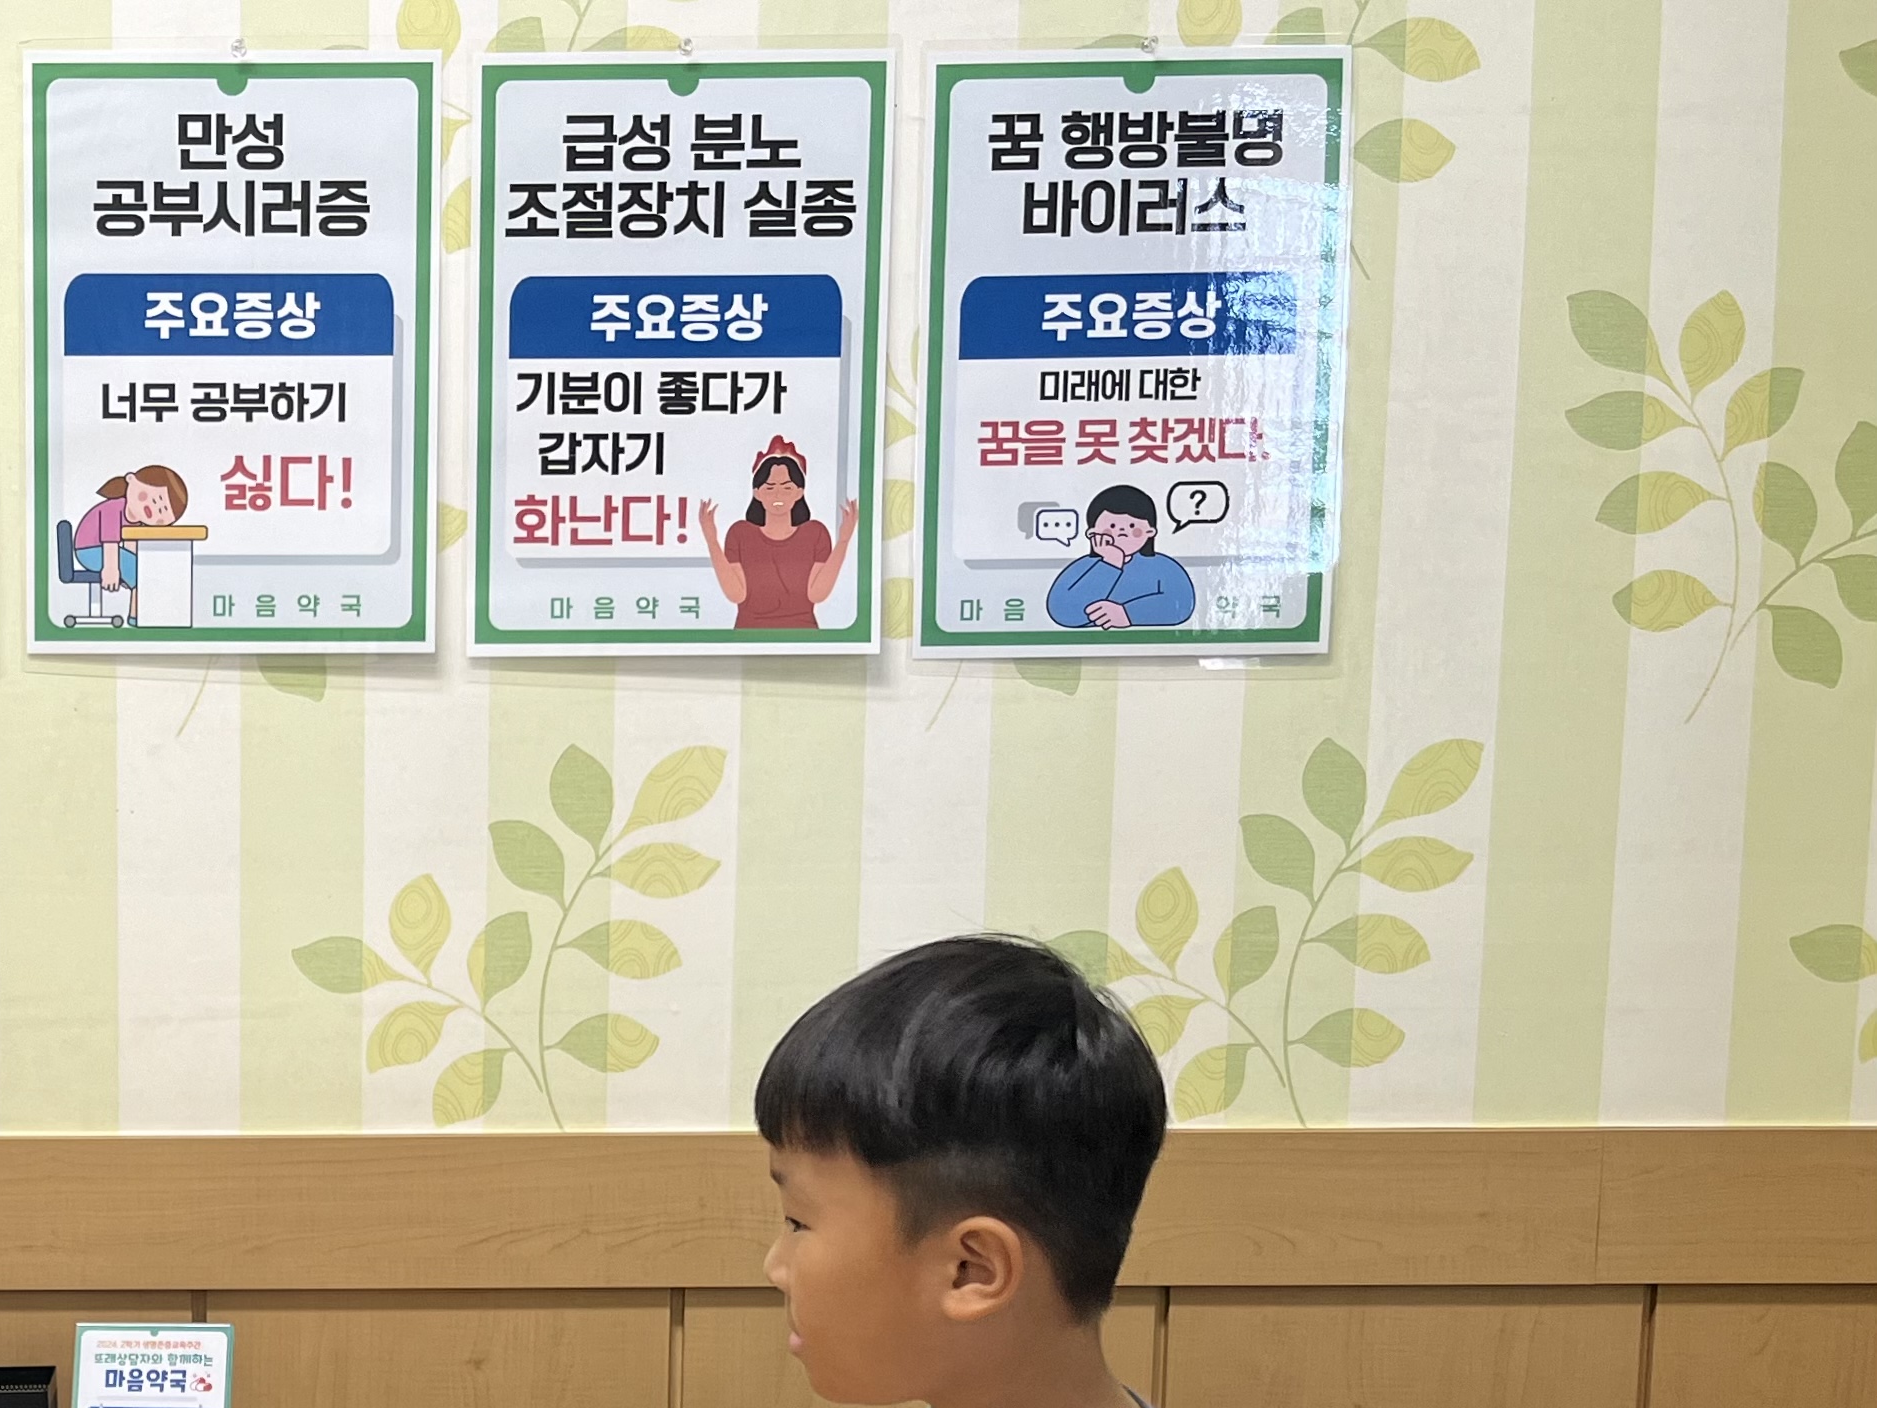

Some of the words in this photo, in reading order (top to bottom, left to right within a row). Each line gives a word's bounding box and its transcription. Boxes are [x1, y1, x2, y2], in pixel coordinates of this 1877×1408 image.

[177, 112, 285, 169] 만성
[562, 113, 670, 171] 급성
[689, 112, 802, 171] 분노
[988, 113, 1044, 171] 꿈
[1061, 110, 1284, 170] 행방불명
[93, 179, 371, 238] 공부시러증
[505, 180, 726, 239] 조절장치
[743, 180, 857, 239] 실종
[1023, 177, 1246, 237] 바이러스
[143, 291, 320, 339] 주요증상
[589, 293, 768, 342] 주요증상
[1041, 291, 1222, 341] 주요증상
[101, 383, 178, 423] 너무
[190, 382, 348, 424] 공부하기
[516, 371, 642, 415] 기분이
[656, 371, 787, 415] 좋다가
[1038, 367, 1132, 402] 미래에
[1138, 367, 1200, 402] 대한
[538, 432, 664, 475] 갑자기
[978, 419, 1066, 466] 꿈을
[1075, 418, 1120, 465] 못
[220, 455, 354, 511] 싫다!
[513, 493, 689, 547] 화난다!
[94, 1353, 162, 1366] 또래상담자와
[167, 1353, 213, 1367] 함께하는
[105, 1368, 187, 1393] 마음약국
